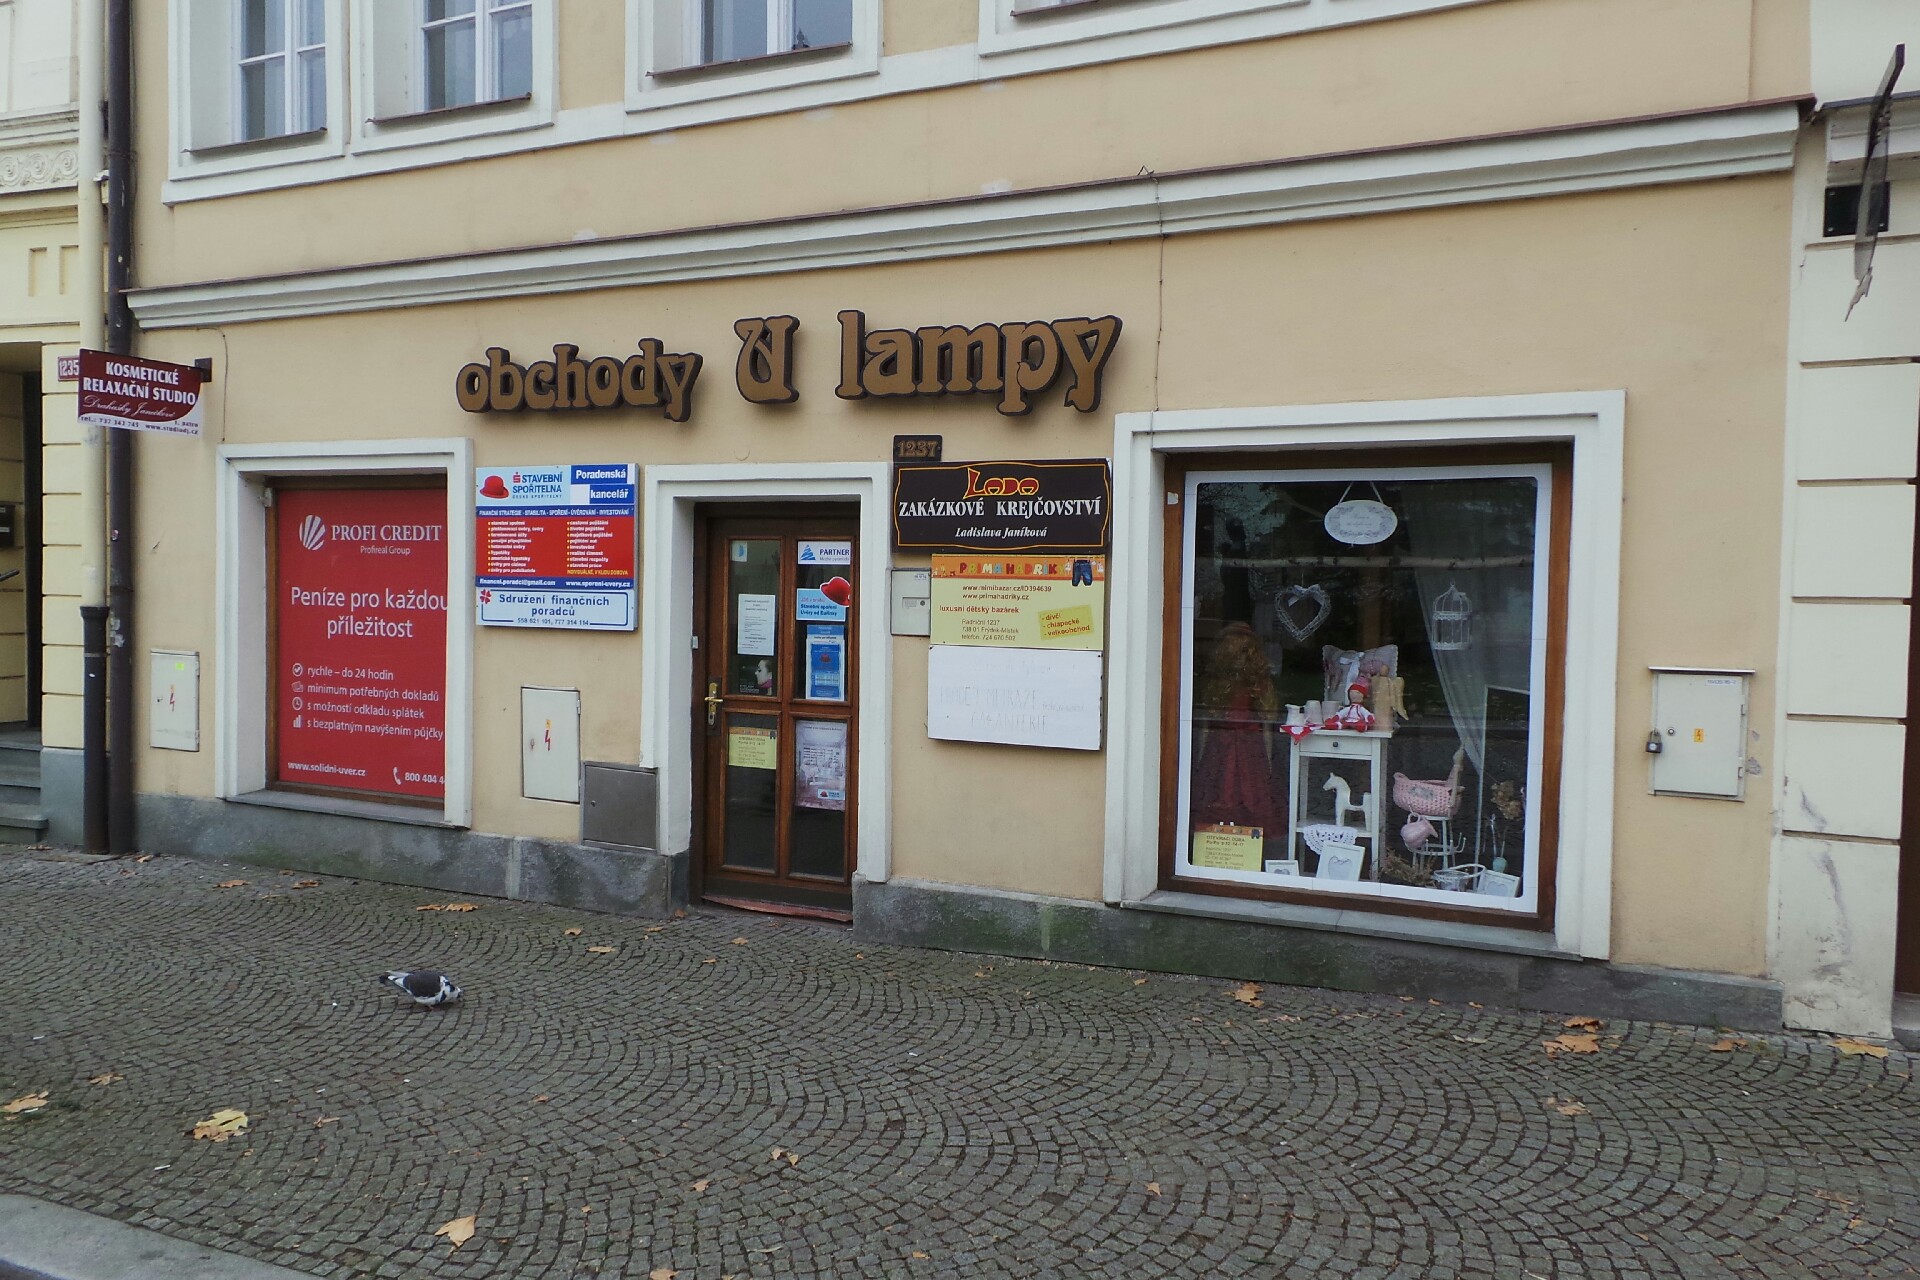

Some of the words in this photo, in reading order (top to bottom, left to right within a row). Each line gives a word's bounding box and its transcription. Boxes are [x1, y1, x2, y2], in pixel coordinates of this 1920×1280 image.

[59, 360, 79, 376] 1235
[106, 361, 178, 385] KOSMETICKÉ
[456, 338, 703, 422] obchody
[735, 315, 801, 404] U
[835, 310, 1123, 416] lampy
[83, 378, 149, 398] RELAXAČNÍ
[153, 388, 196, 405] STUDIO
[898, 441, 936, 457] 1237
[522, 471, 563, 483] STAVEBNÍ
[576, 469, 626, 480] Poradenská
[513, 484, 562, 493] SPOŘITELNA
[590, 489, 629, 499] kancelář
[899, 497, 984, 517] ZAKÁZKOVÉ
[996, 497, 1101, 519] KREJČOVSTVÍ
[331, 525, 375, 540] PROFI
[380, 525, 441, 540] CREDIT
[955, 527, 1001, 537] Ladislava
[1002, 527, 1047, 539] Janíková
[361, 546, 387, 554] Profireal
[389, 546, 410, 555] Group
[959, 562, 1003, 574] PRIMA
[291, 587, 345, 606] Peníze
[350, 593, 379, 612] pro
[385, 588, 448, 610] každou
[499, 594, 545, 603] Sdružení
[551, 595, 609, 605] finančních
[532, 607, 575, 617] poradců
[327, 615, 413, 639] příležitost
[308, 666, 332, 677] rychle
[342, 667, 353, 677] do
[355, 669, 365, 678] 24
[368, 669, 393, 680] hodin
[308, 683, 347, 694] minimum
[350, 687, 399, 700] potřebných
[402, 689, 439, 701] dokladů
[314, 702, 351, 713] možností
[354, 704, 389, 716] odkladu
[392, 708, 424, 719] splátek
[313, 718, 362, 733] bezplatným
[365, 722, 411, 736] navýšením
[414, 727, 443, 741] půjčky
[288, 762, 366, 776] www.solidni-uver.cz
[405, 772, 420, 781] 800
[422, 773, 437, 782] 404
